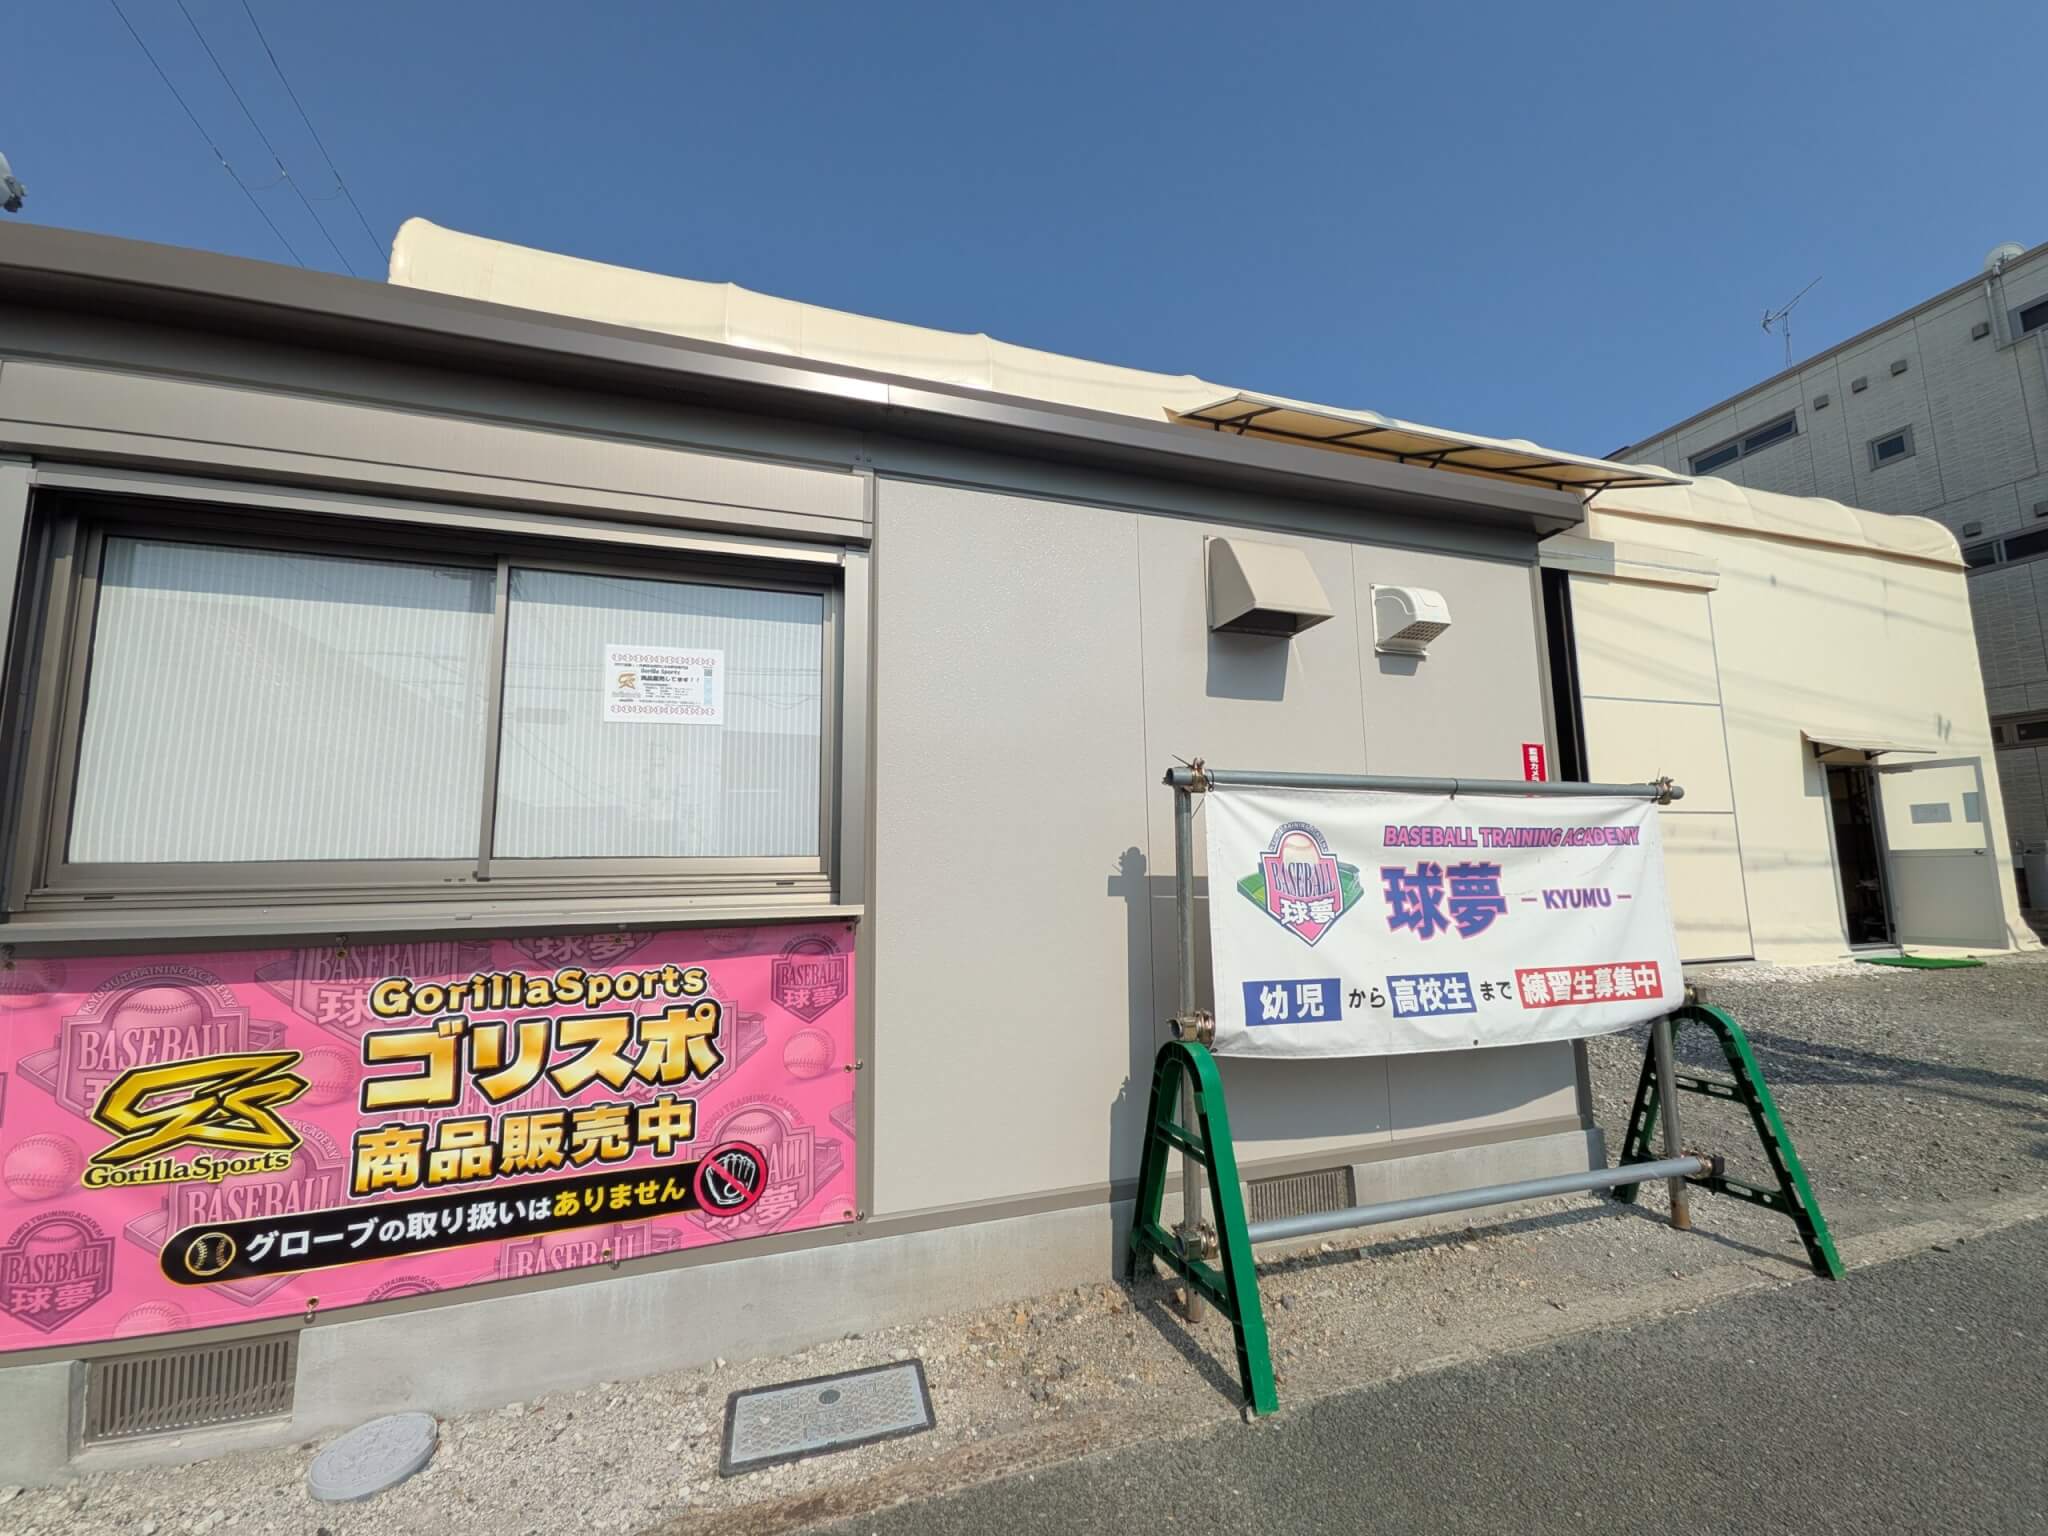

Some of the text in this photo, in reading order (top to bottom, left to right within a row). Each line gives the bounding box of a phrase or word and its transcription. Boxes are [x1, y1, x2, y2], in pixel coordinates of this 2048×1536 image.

[1384, 825, 1640, 847] BASEBALL TRAINING ACADEMY
[1271, 862, 1336, 897] BASEBALL
[1280, 897, 1336, 925] 球夢
[1380, 861, 1508, 941] 球夢
[1542, 888, 1612, 909] KYUMU
[781, 962, 841, 987] BASEBALL
[783, 985, 838, 1009] 球夢
[1259, 965, 1658, 1020] 幼児 から 高校生 まで 練習生募集中
[362, 1000, 724, 1112] ゴリスポ
[351, 1094, 696, 1196] 商品販売中
[8, 1249, 101, 1285] BASEBALL
[10, 1281, 96, 1313] 球夢
